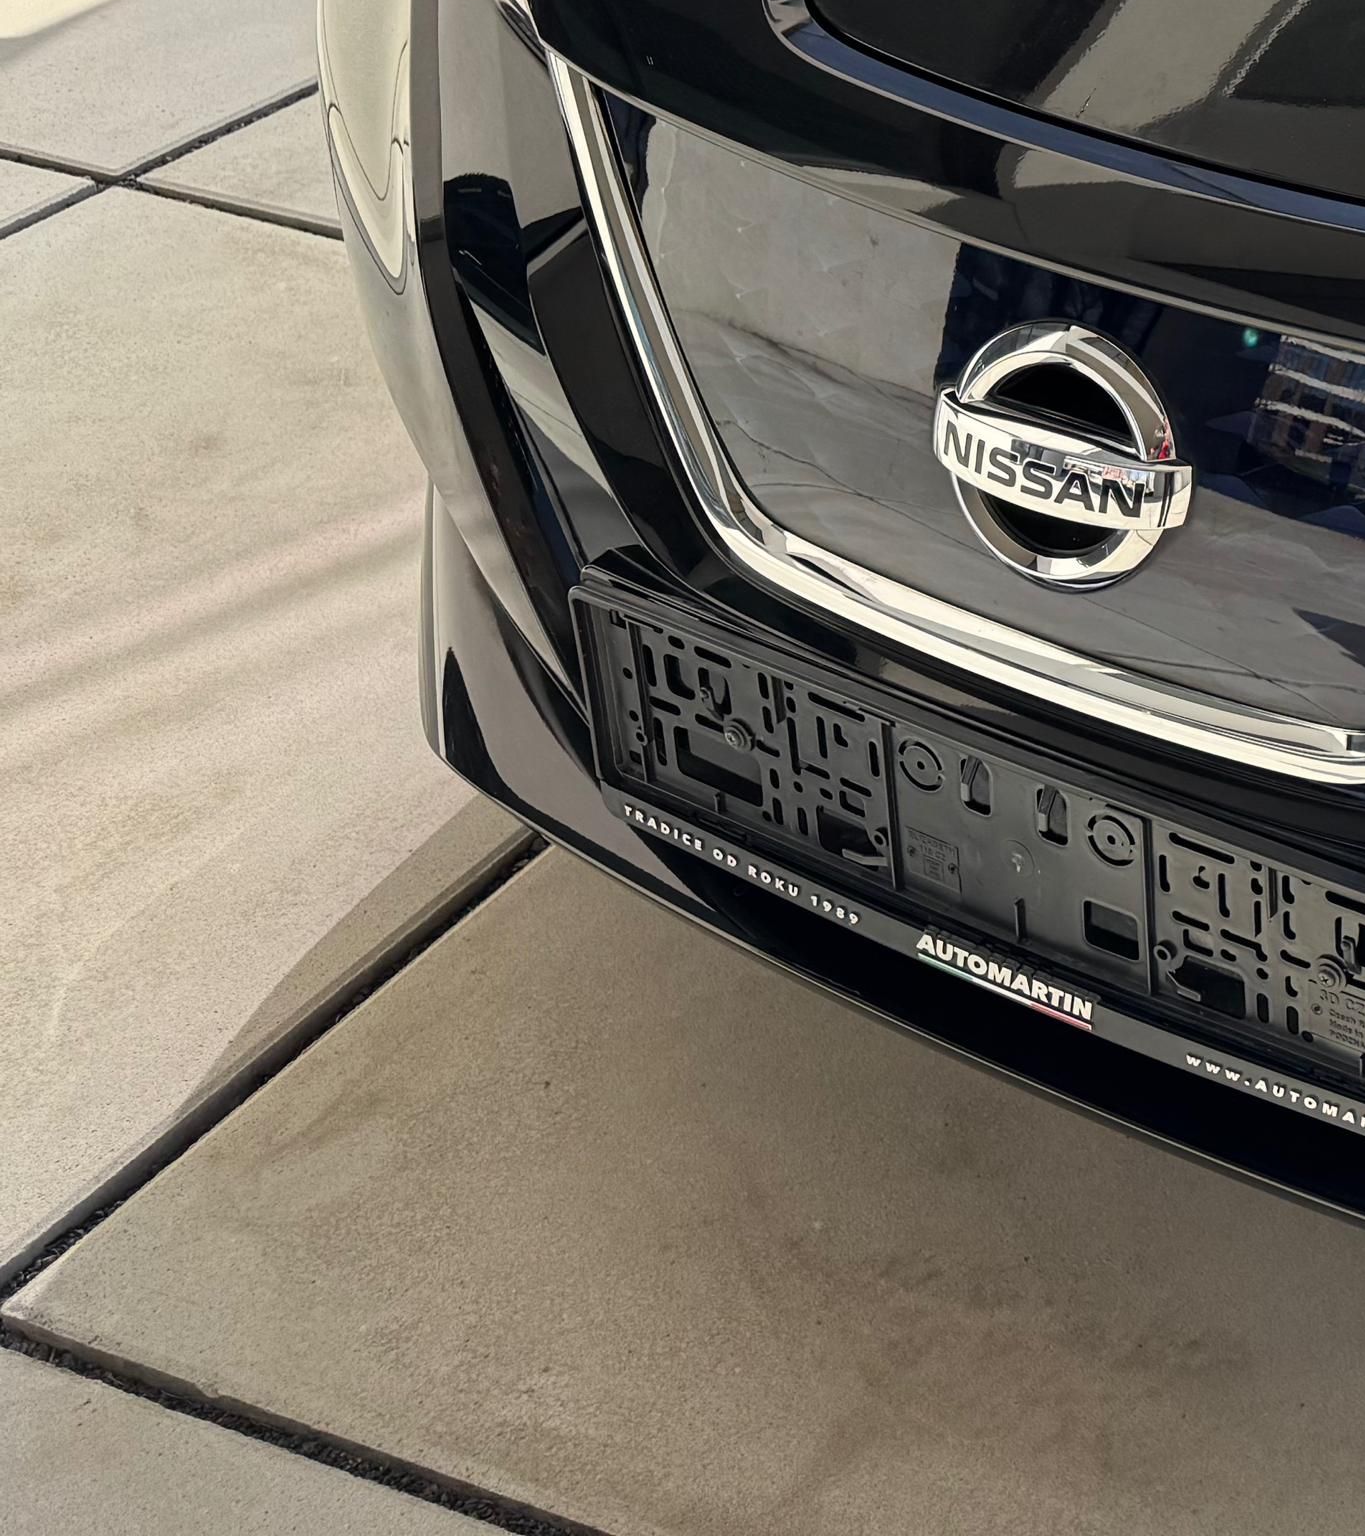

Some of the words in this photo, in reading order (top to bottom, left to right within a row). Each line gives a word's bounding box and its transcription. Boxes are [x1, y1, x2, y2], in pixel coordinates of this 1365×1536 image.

[943, 420, 1146, 519] NISSAN
[623, 803, 703, 851] TRADICE
[712, 847, 738, 868] OD
[748, 864, 799, 897] ROKU
[810, 894, 860, 925] 1989
[916, 933, 1093, 1021] AUTOMARTIN
[1345, 998, 1365, 1017] CZ
